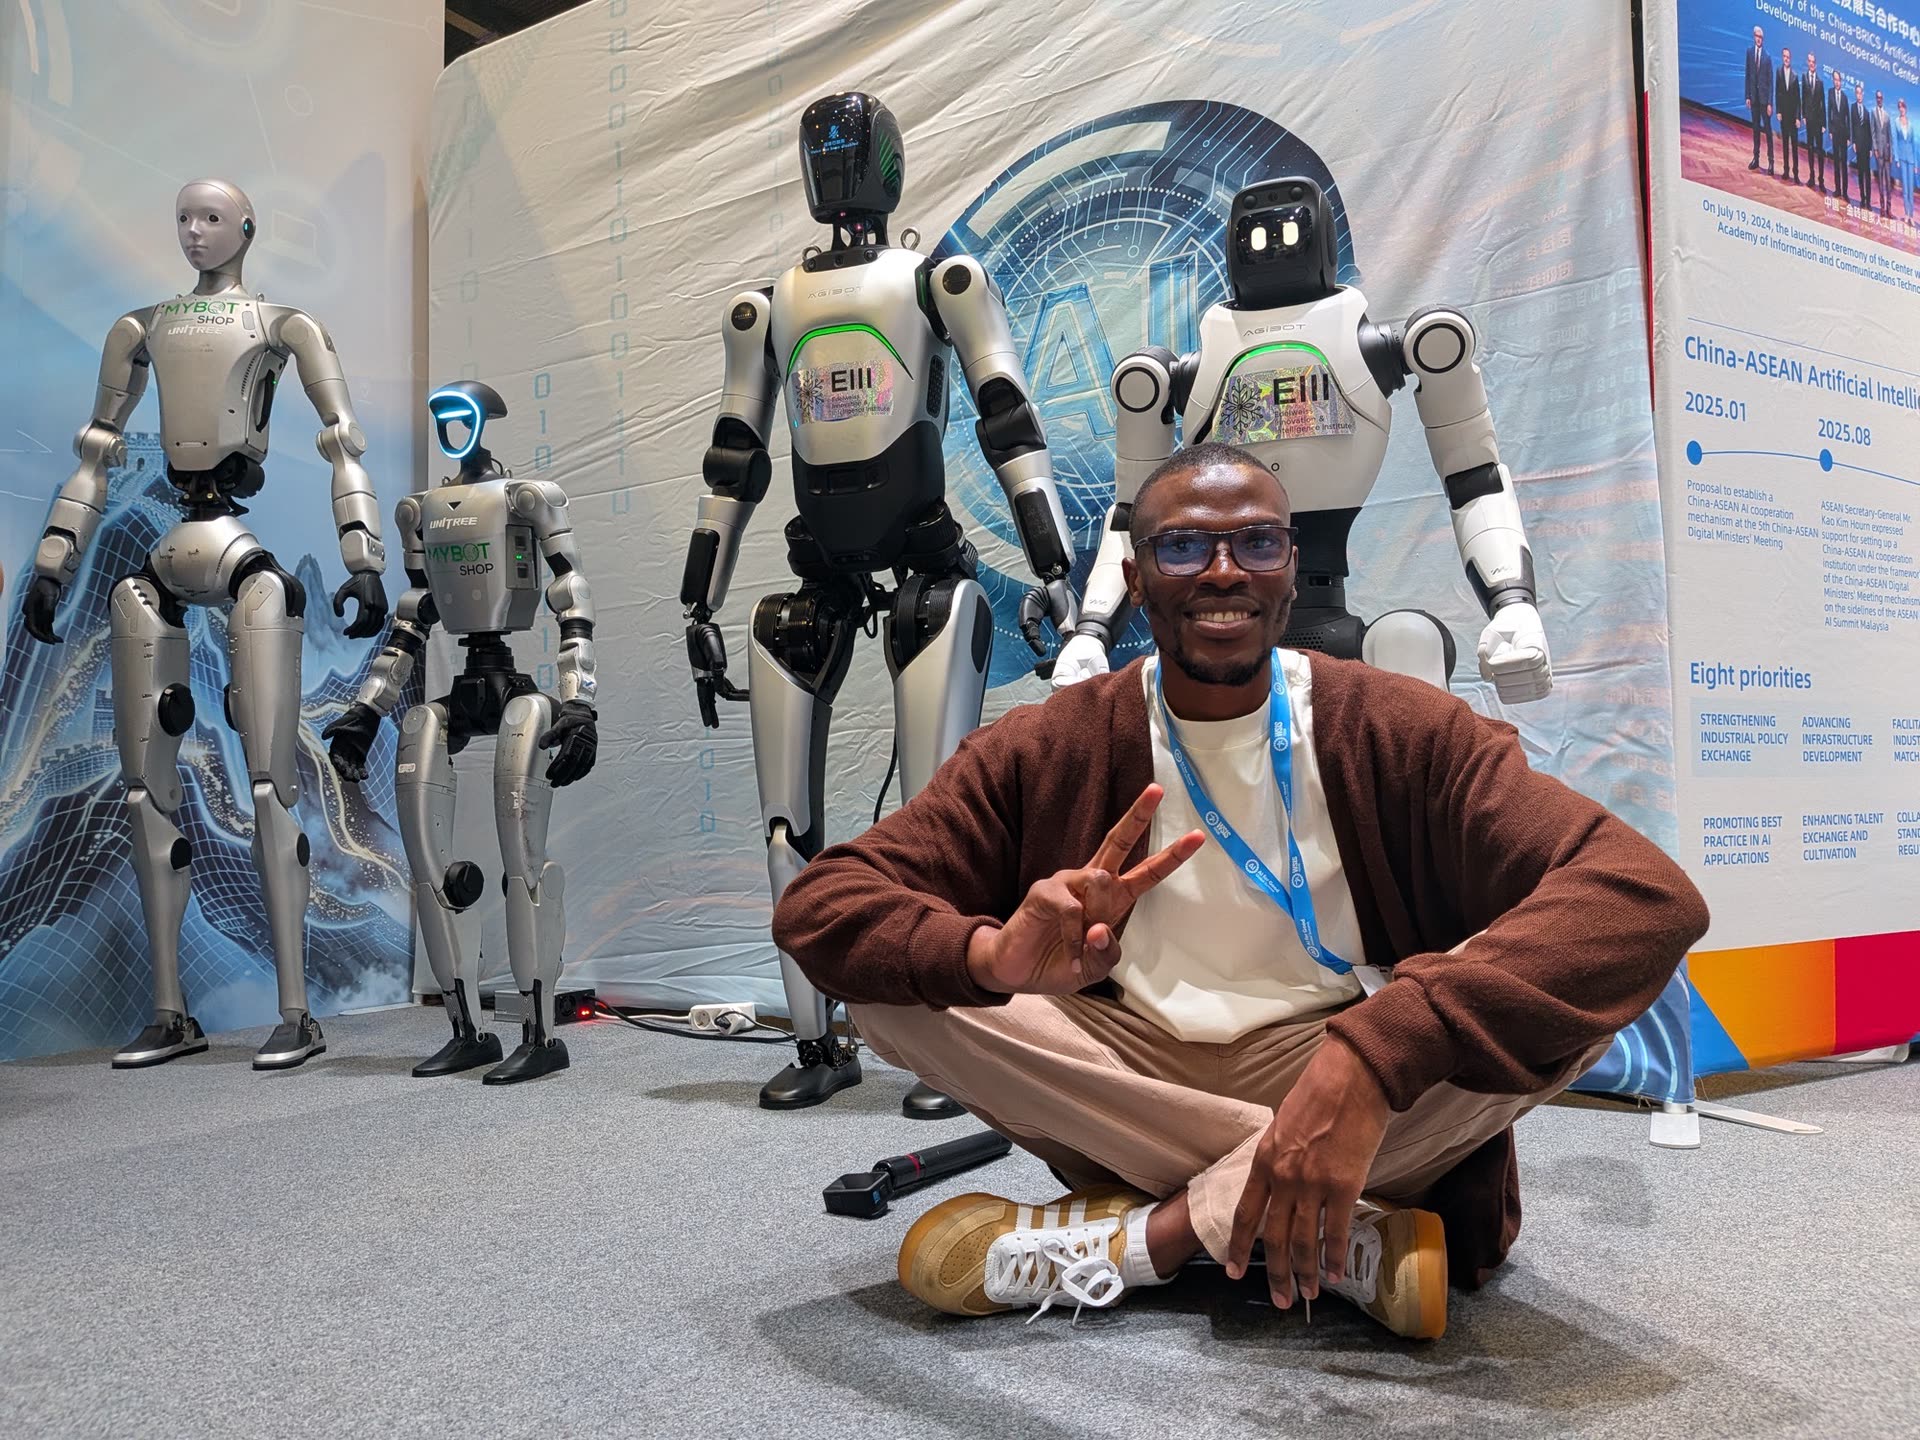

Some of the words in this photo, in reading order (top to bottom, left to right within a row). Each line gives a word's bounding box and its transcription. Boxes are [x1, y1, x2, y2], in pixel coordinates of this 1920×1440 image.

[1797, 1, 1807, 13] of
[1810, 4, 1825, 21] the
[1828, 12, 1882, 50] China-BRICS
[1756, 0, 1817, 37] Development
[1820, 29, 1836, 45] and
[1839, 36, 1891, 72] Cooperation
[1892, 62, 1920, 85] Center
[1702, 199, 1716, 213] On
[1717, 203, 1734, 220] July
[1736, 210, 1749, 226] 19,
[1751, 214, 1774, 233] 2024,
[1775, 221, 1789, 237] the
[1790, 226, 1830, 252] launching
[1831, 241, 1868, 264] ceremony
[1869, 253, 1877, 264] of
[1878, 255, 1890, 269] the
[1890, 260, 1913, 276] Center
[1717, 221, 1758, 246] Academy
[1759, 235, 1769, 246] of
[1770, 237, 1817, 261] Information
[1819, 253, 1834, 267] and
[1835, 257, 1896, 286] Communications
[165, 301, 240, 316] MYBOT
[197, 315, 235, 326] SHOP
[168, 324, 225, 336] UNITREE
[1243, 323, 1307, 337] AGIBOT
[1684, 336, 1803, 384] China-ASEAN
[1807, 365, 1874, 400] Artificial
[831, 367, 872, 392] EIII
[1273, 373, 1329, 405] EIII
[1684, 391, 1747, 422] 2025.01
[1817, 418, 1872, 447] 2025.08
[1687, 479, 1722, 494] Proposal
[1723, 485, 1732, 496] to
[1733, 487, 1767, 502] establish
[1768, 493, 1774, 502] a
[1687, 495, 1739, 513] China-ASEAN
[1741, 503, 1749, 513] AI
[1750, 505, 1794, 520] cooperation
[1821, 500, 1844, 513] ASEAN
[1844, 504, 1902, 522] Secretary-General
[429, 516, 479, 530] UNITREE
[1688, 511, 1733, 527] mechanism
[1735, 518, 1742, 528] at
[1744, 518, 1757, 530] the
[1758, 520, 1770, 532] 5th
[1771, 522, 1819, 538] China-ASEAN
[1821, 514, 1835, 526] Kao
[1836, 516, 1849, 528] Kim
[1871, 523, 1904, 536] expressed
[1688, 526, 1714, 540] Digital
[1715, 529, 1752, 545] Ministers'
[1753, 534, 1784, 550] Meeting
[1821, 530, 1848, 543] support
[1849, 532, 1859, 544] for
[1860, 535, 1882, 549] setting
[1883, 540, 1893, 550] up
[426, 542, 491, 563] MYBOT
[1822, 543, 1867, 559] China-ASEAN
[1867, 550, 1875, 560] AI
[1875, 552, 1913, 564] cooperation
[459, 562, 494, 576] SHOP
[1857, 562, 1877, 574] under
[1878, 565, 1889, 575] the
[1823, 573, 1831, 583] of
[1831, 573, 1843, 584] the
[1844, 575, 1888, 589] China-ASEAN
[1888, 580, 1909, 592] Digital
[1856, 591, 1883, 605] Meeting
[1824, 603, 1834, 612] on
[1834, 602, 1846, 614] the
[1847, 604, 1876, 617] sidelines
[1877, 606, 1885, 617] of
[1885, 607, 1896, 618] the
[1896, 609, 1919, 620] ASEAN
[1824, 616, 1832, 627] AI
[1833, 617, 1859, 629] Summit
[1860, 619, 1889, 633] Malaysia
[1690, 661, 1735, 690] Eight
[1739, 665, 1812, 691] priorities
[1700, 713, 1776, 727] STRENGTHENING
[1801, 716, 1851, 728] ADVANCING
[1701, 731, 1755, 744] INDUSTRIAL
[1757, 732, 1789, 745] POLICY
[1802, 733, 1873, 746] INFRASTRUCTURE
[1701, 750, 1751, 762] EXCHANGE
[1803, 750, 1863, 762] DEVELOPMENT
[1894, 751, 1920, 762] MATCH
[1703, 816, 1759, 829] PROMOTING
[1761, 815, 1782, 828] BEST
[1802, 813, 1853, 826] ENHANCING
[1854, 812, 1884, 825] TALENT
[1216, 821, 1232, 839] WSIS
[1803, 831, 1848, 843] EXCHANGE
[1850, 830, 1868, 841] AND
[1703, 834, 1748, 847] PRACTICE
[1750, 834, 1760, 846] IN
[1761, 834, 1771, 846] AI
[1803, 848, 1857, 861] CULTIVATION
[1898, 844, 1919, 856] REGU
[1703, 852, 1770, 866] APPLICATIONS
